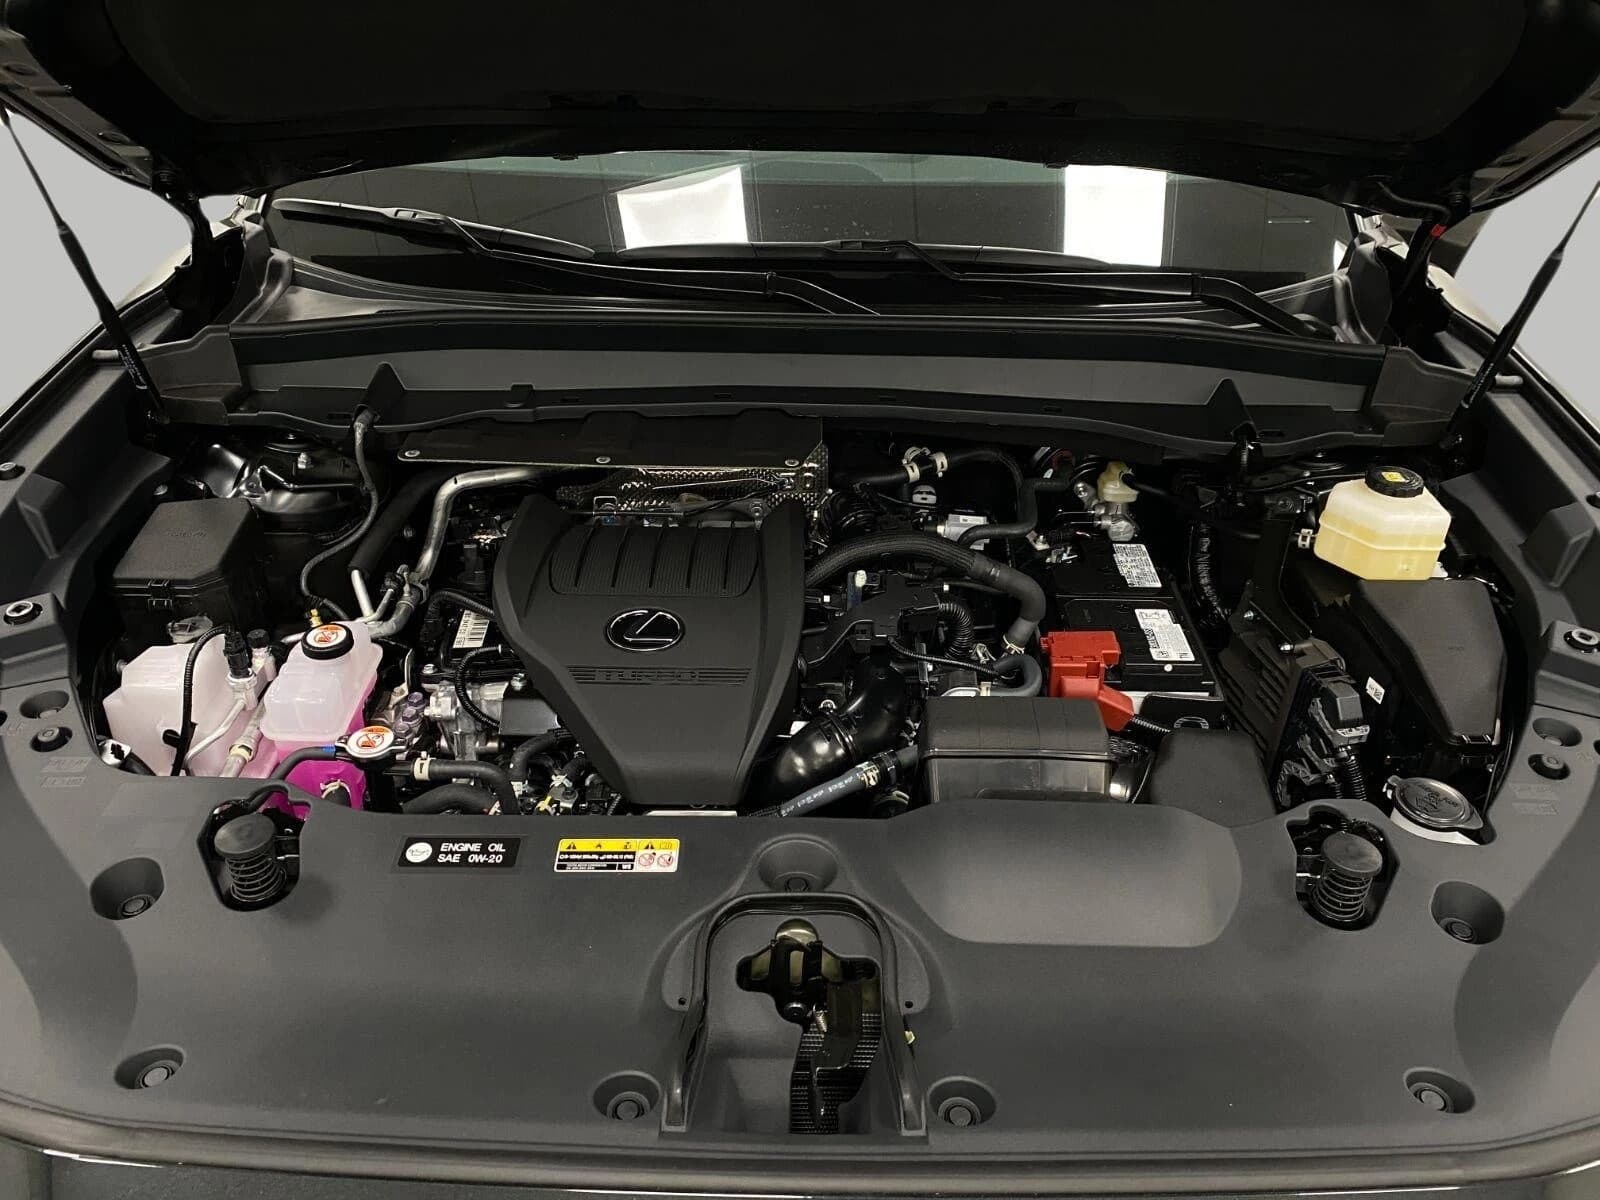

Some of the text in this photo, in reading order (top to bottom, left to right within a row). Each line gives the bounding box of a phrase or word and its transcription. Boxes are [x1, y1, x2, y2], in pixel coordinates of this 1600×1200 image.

[440, 842, 506, 852] ENGINE OIL
[437, 853, 503, 863] SAE 0W-20
